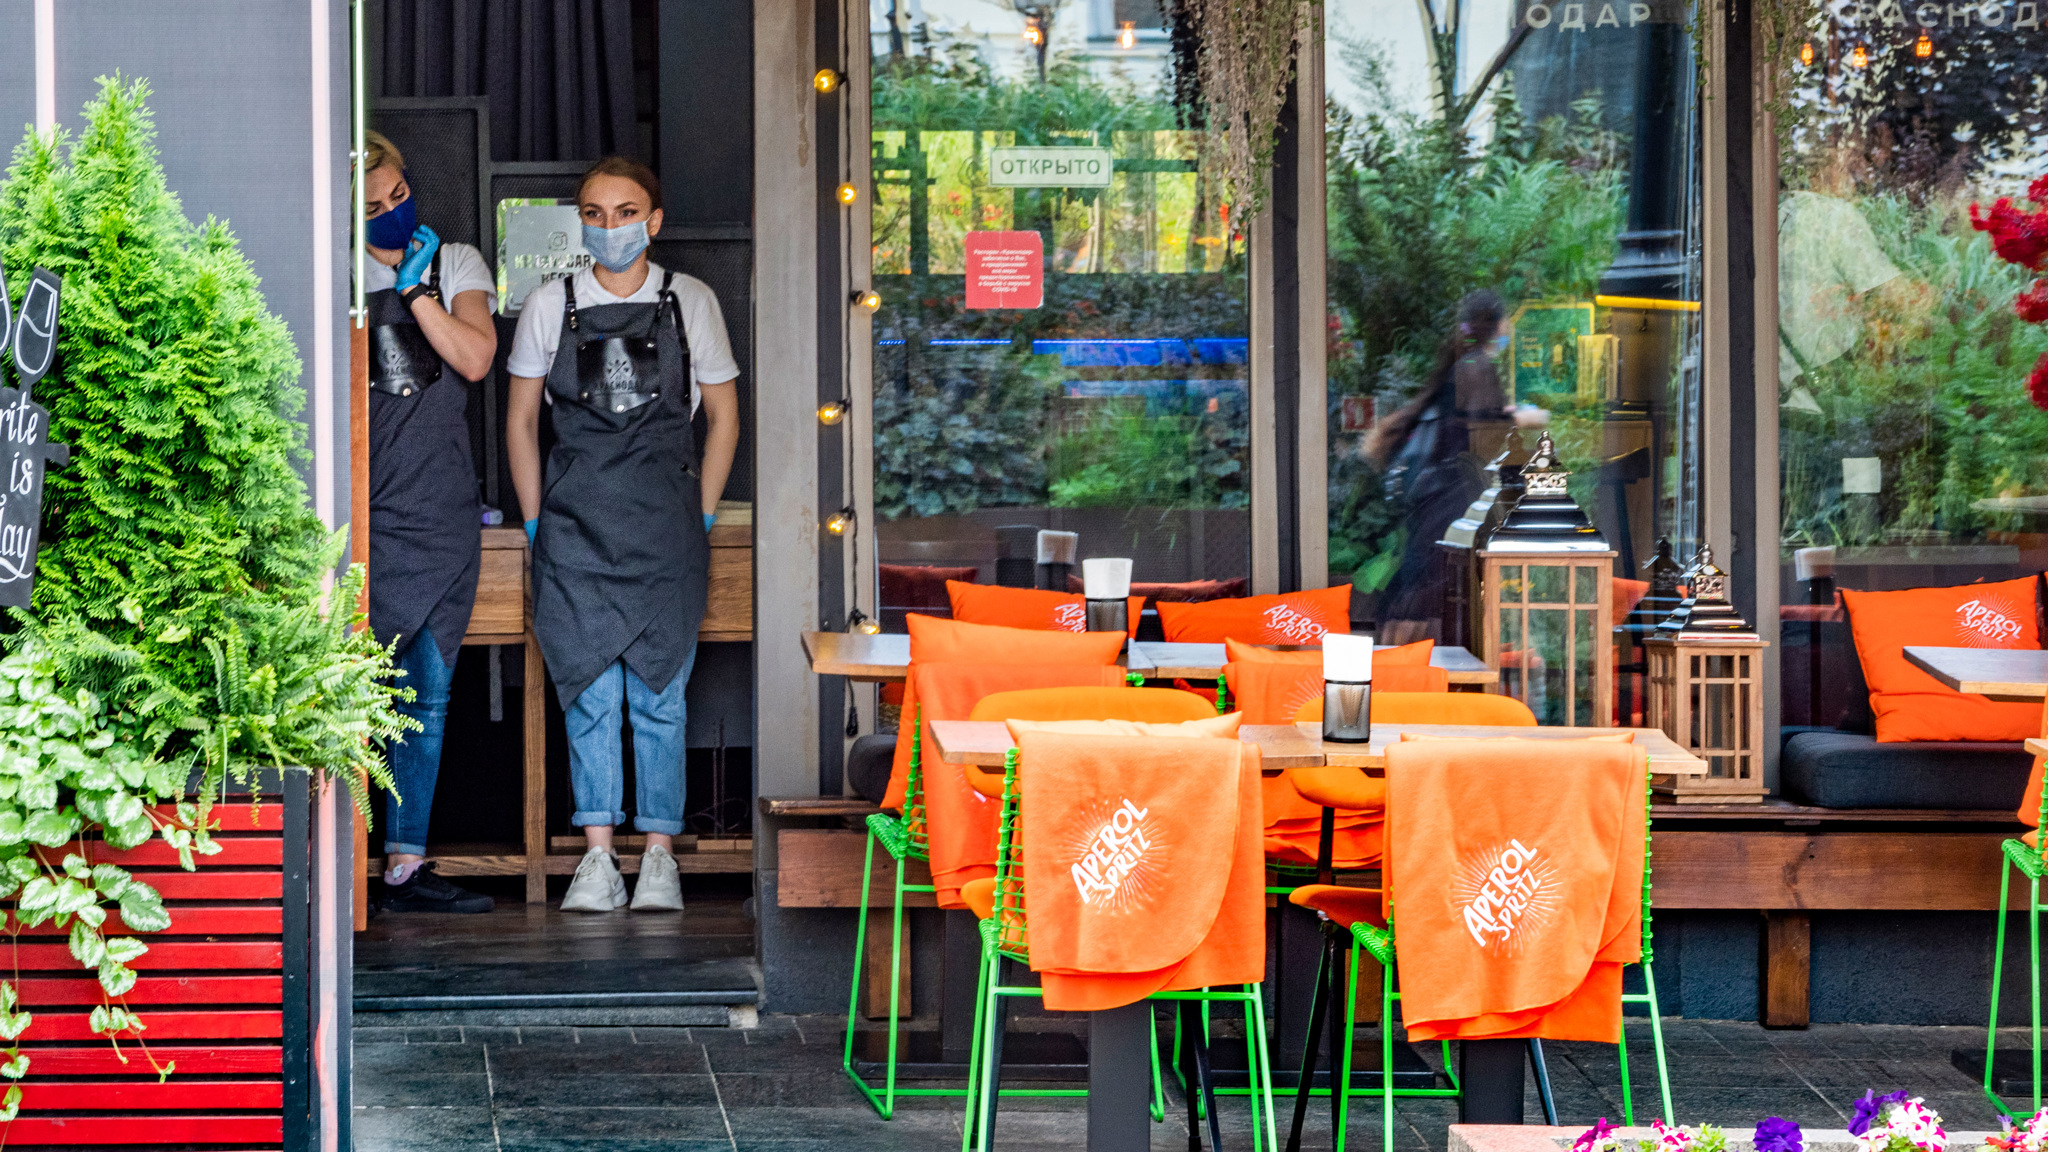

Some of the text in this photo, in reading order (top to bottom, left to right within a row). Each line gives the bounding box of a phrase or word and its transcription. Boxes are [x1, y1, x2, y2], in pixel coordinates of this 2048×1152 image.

[1000, 159, 1101, 175] ОТКРЫТО
[10, 451, 33, 495] is
[1956, 600, 2022, 639] APEROL
[1070, 798, 1149, 905] APEROL
[1463, 838, 1538, 948] APEROL
